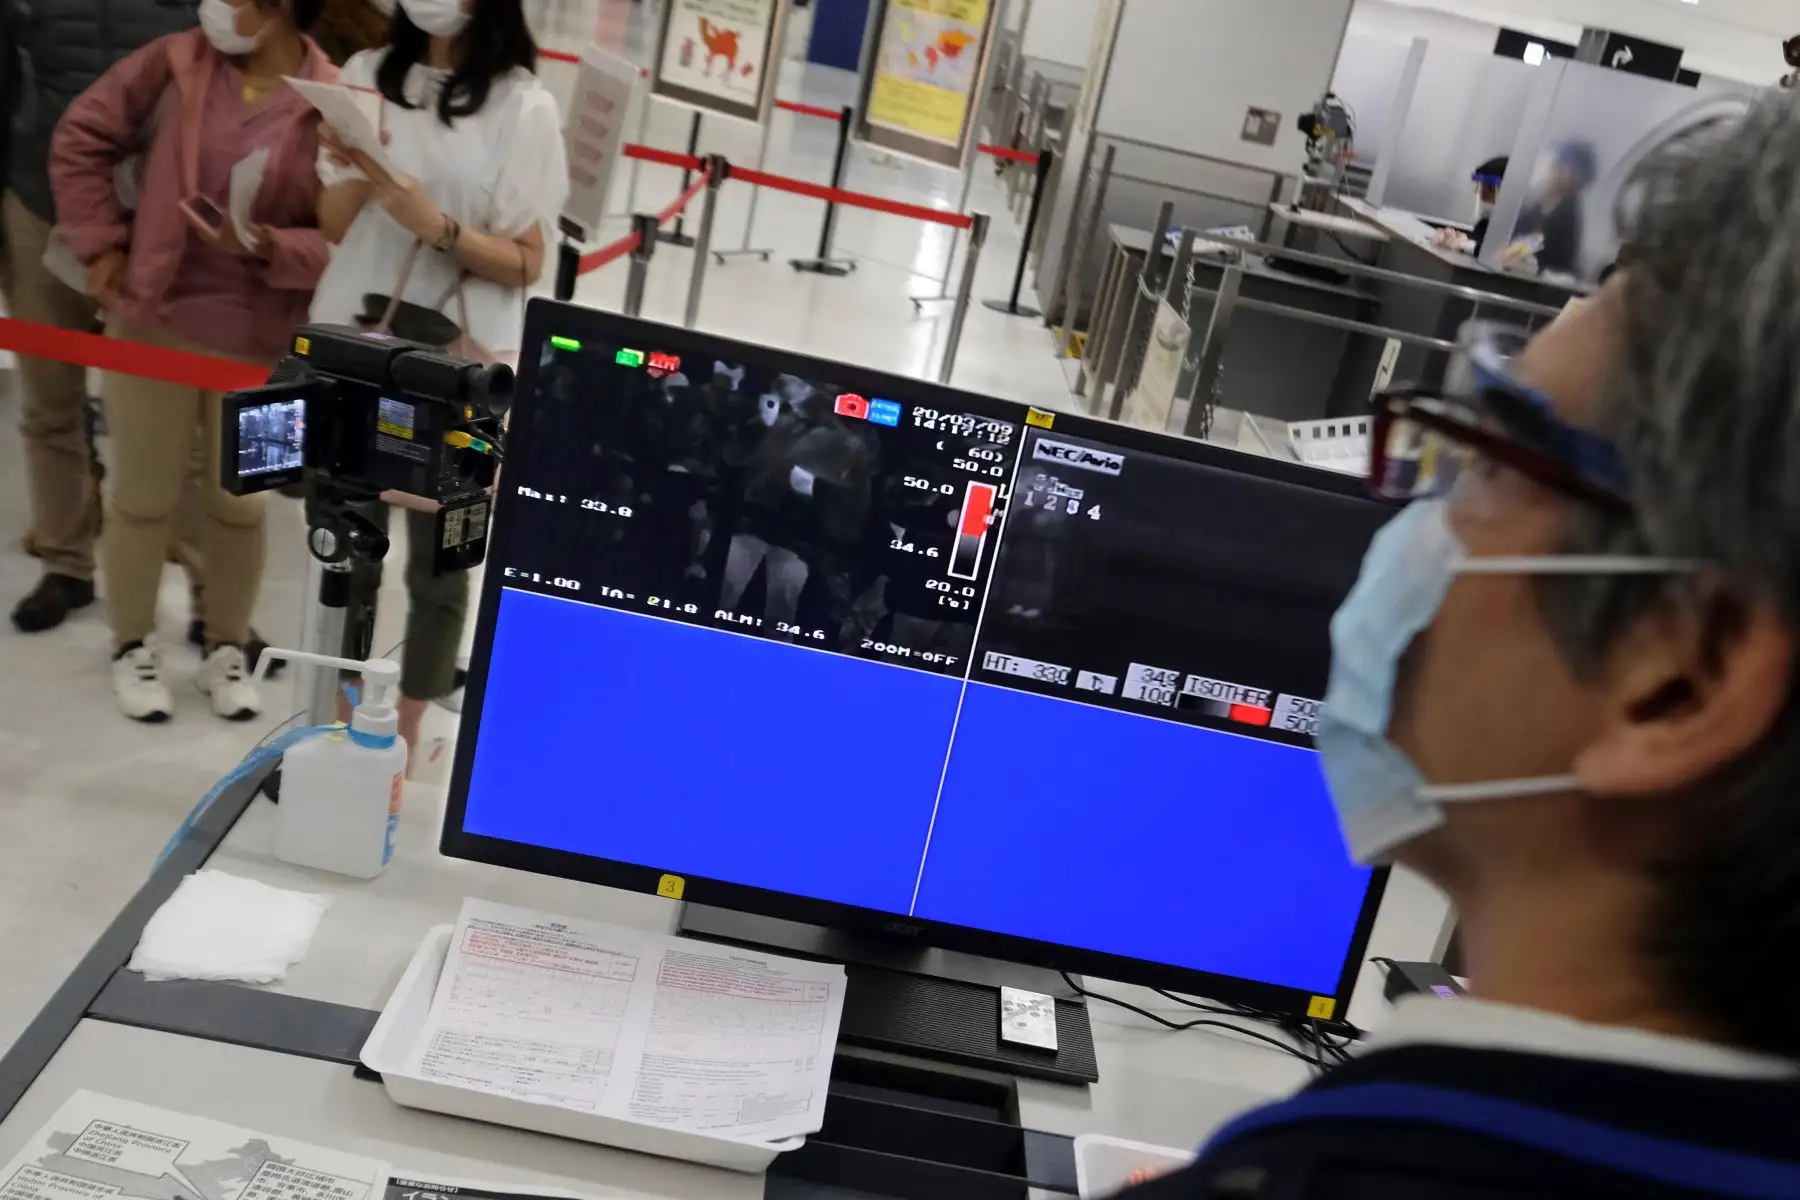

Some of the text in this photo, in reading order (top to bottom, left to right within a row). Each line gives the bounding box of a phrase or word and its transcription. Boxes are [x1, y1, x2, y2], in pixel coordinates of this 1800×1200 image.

[912, 406, 1013, 436] 20/03/09
[953, 458, 1003, 477] 50.0
[904, 476, 954, 495] 50.0
[580, 499, 633, 517] 33.8
[1024, 490, 1034, 507] 1
[1043, 495, 1058, 511] 2
[1087, 504, 1101, 520] 4
[890, 539, 939, 557] 34.6
[925, 579, 975, 597] 20.0
[504, 567, 581, 590] E=1.00
[714, 609, 763, 628] ALM:
[776, 621, 825, 640] 34.6
[860, 638, 959, 666] ZOOM=OFF
[985, 653, 1019, 672] HT:
[666, 880, 675, 893] 3
[884, 921, 926, 936] acer
[131, 1140, 172, 1154] Province
